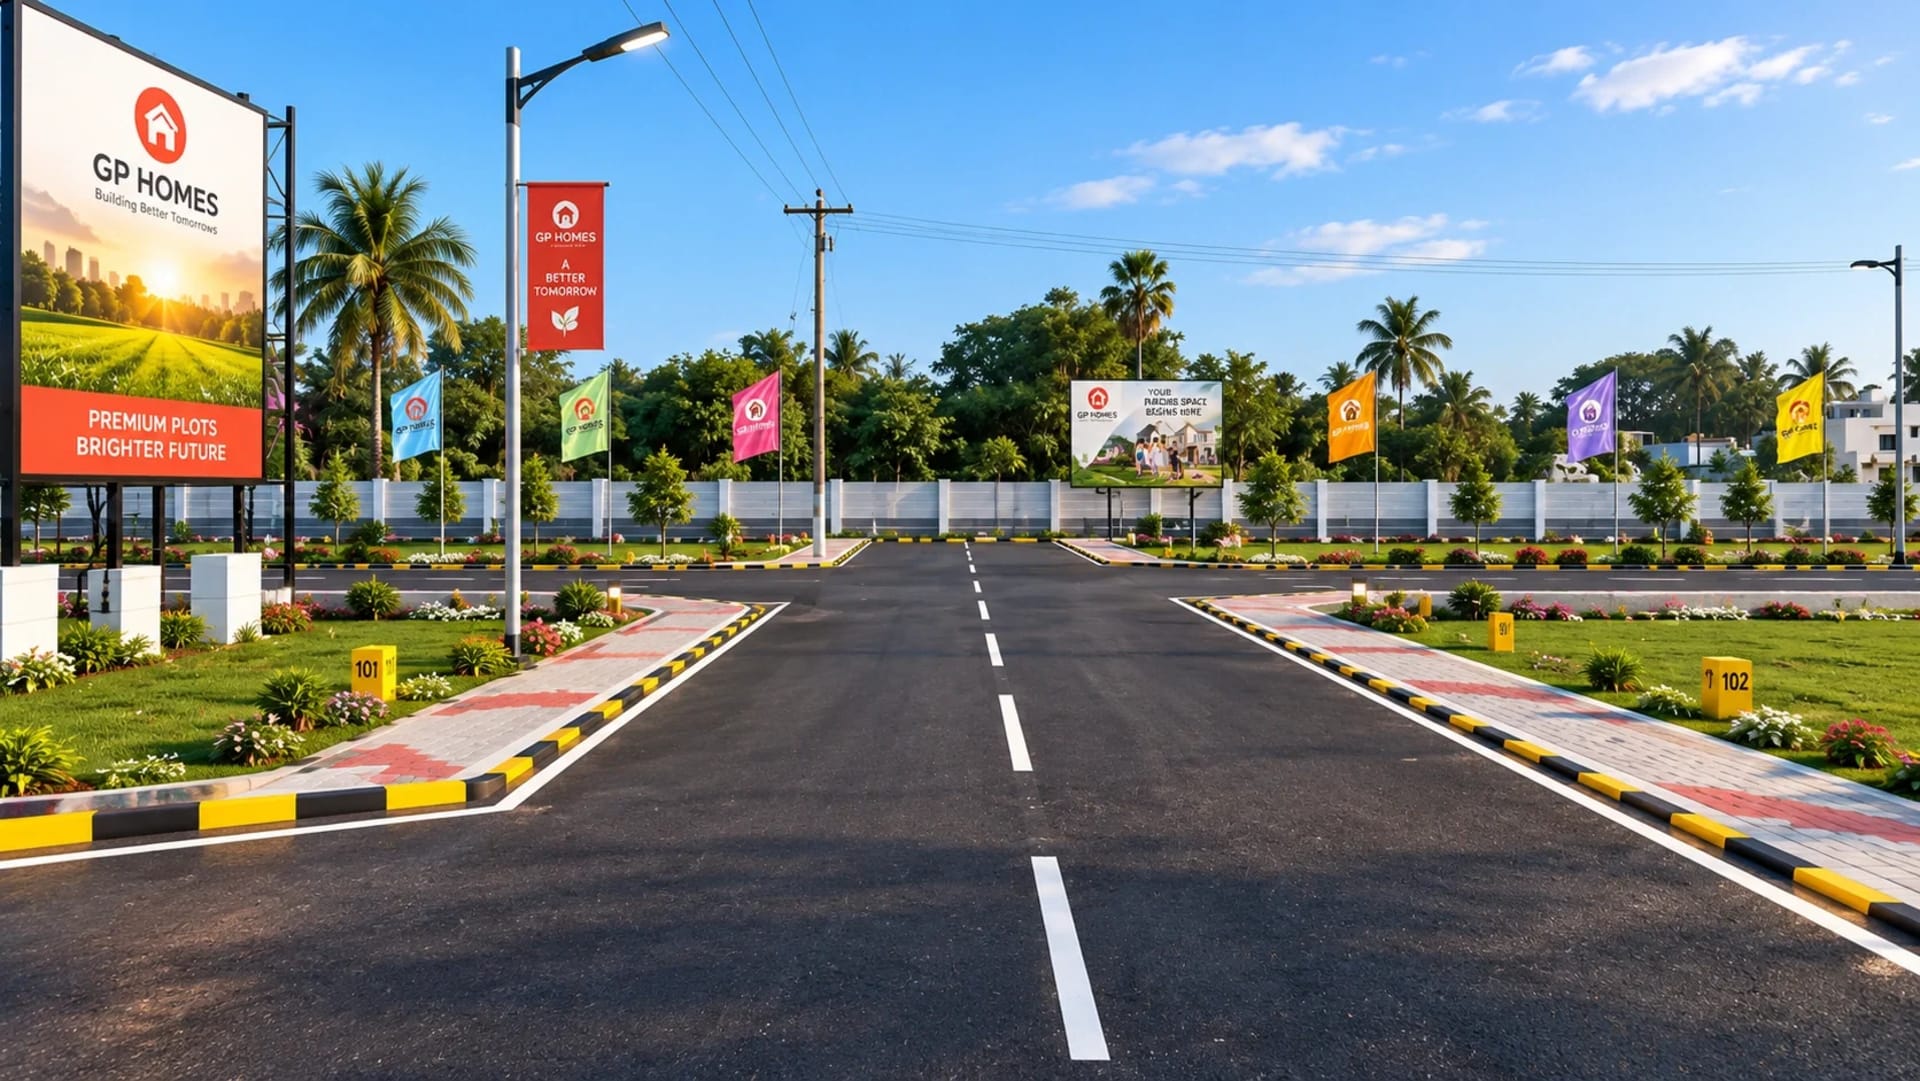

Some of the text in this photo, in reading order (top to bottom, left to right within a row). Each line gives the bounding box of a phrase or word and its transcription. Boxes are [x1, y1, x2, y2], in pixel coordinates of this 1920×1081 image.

[93, 153, 219, 217] GP HOMES
[95, 187, 137, 213] Building
[140, 202, 168, 220] Better
[535, 232, 597, 243] GP HOMES
[561, 259, 570, 270] A
[546, 273, 586, 283] BETTER
[534, 286, 597, 297] TOMORROW
[89, 409, 217, 436] PREMIUM PLOTS
[77, 436, 226, 461] BRIGHTER FUTURE
[355, 660, 377, 678] 101
[1722, 672, 1749, 691] 102
